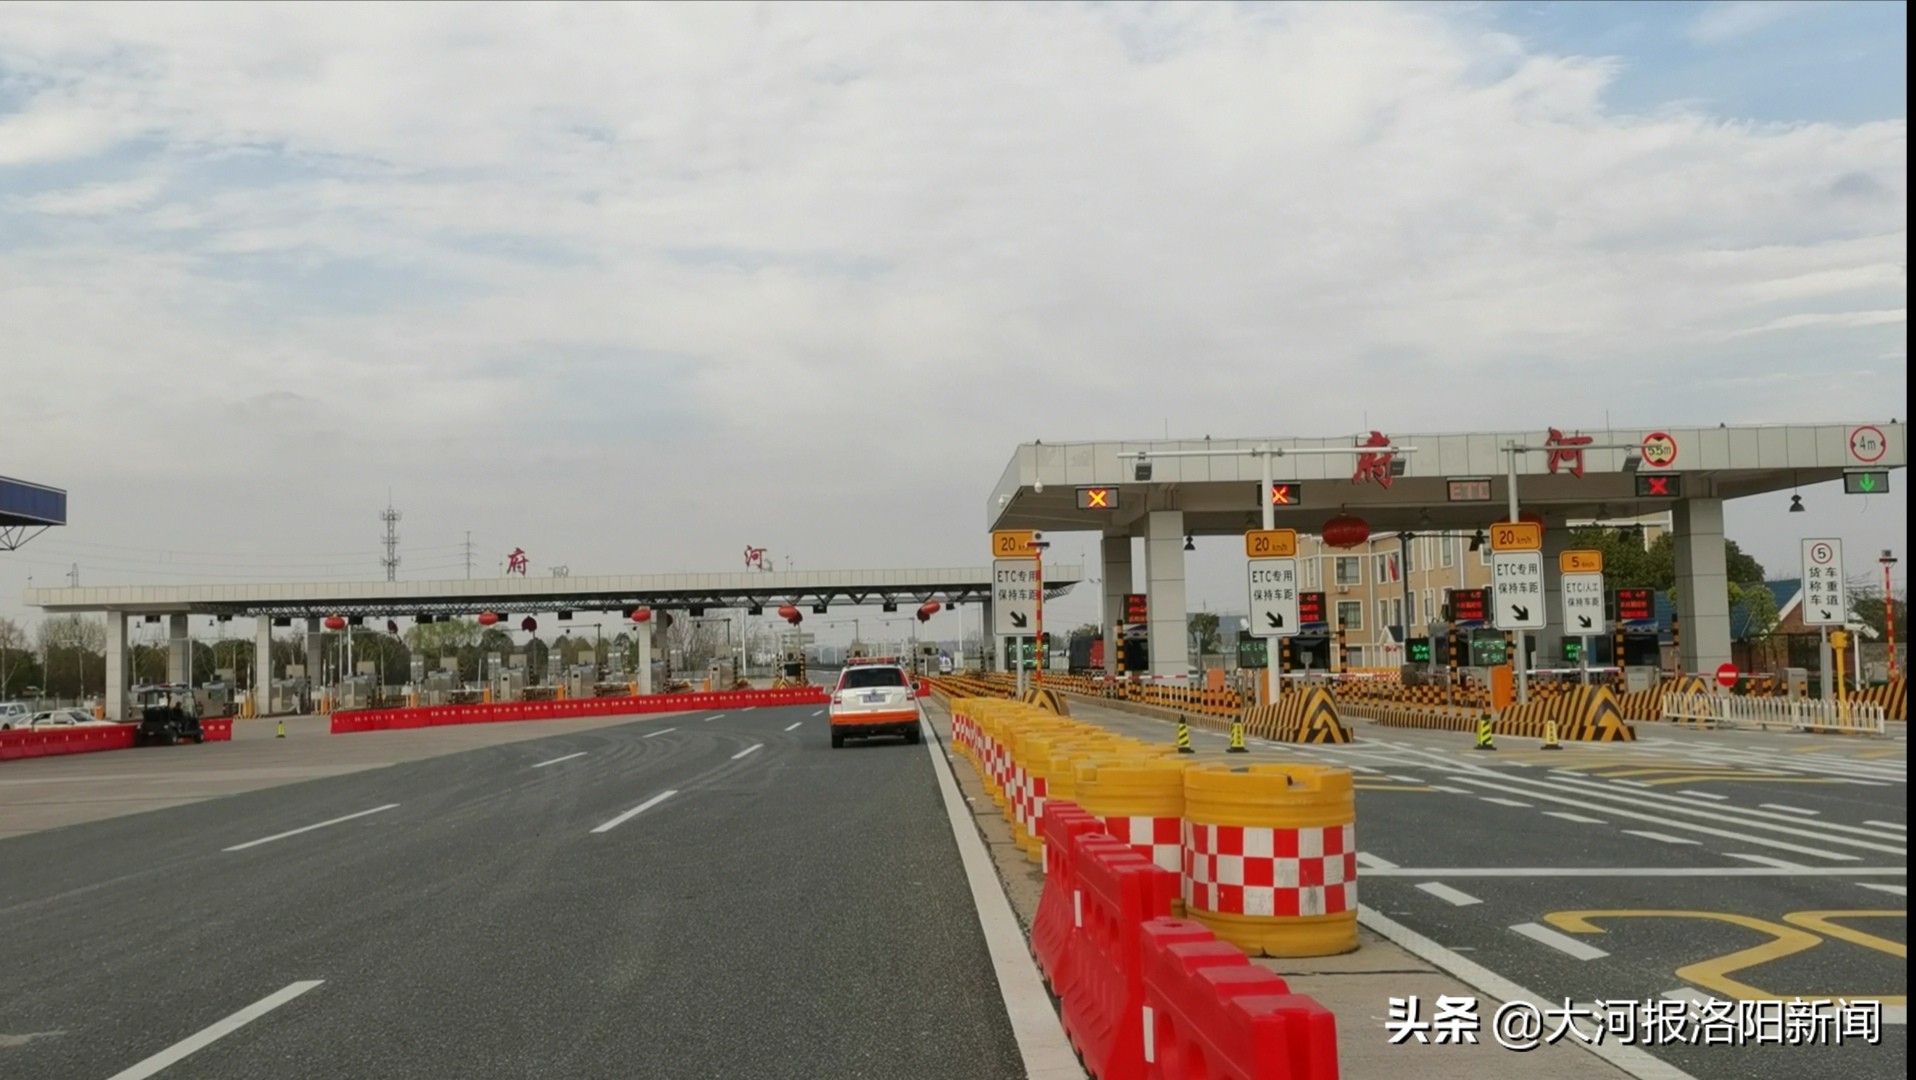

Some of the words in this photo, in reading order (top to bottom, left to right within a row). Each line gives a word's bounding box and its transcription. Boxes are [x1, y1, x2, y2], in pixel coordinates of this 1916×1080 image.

[1860, 436, 1876, 450] 4m
[1352, 431, 1393, 489] 府
[1545, 428, 1594, 479] 河
[1451, 483, 1489, 498] ETC
[1001, 537, 1016, 551] 20
[1255, 536, 1270, 551] 20
[1500, 530, 1514, 545] 20
[1817, 547, 1826, 559] 5
[506, 547, 529, 576] 府
[744, 545, 767, 569] 河
[1571, 556, 1580, 568] 5
[1252, 570, 1293, 583] ETC专用
[1497, 563, 1538, 576] ETC专用
[1253, 588, 1294, 601] 保持车距
[1498, 581, 1539, 594] 保持车距
